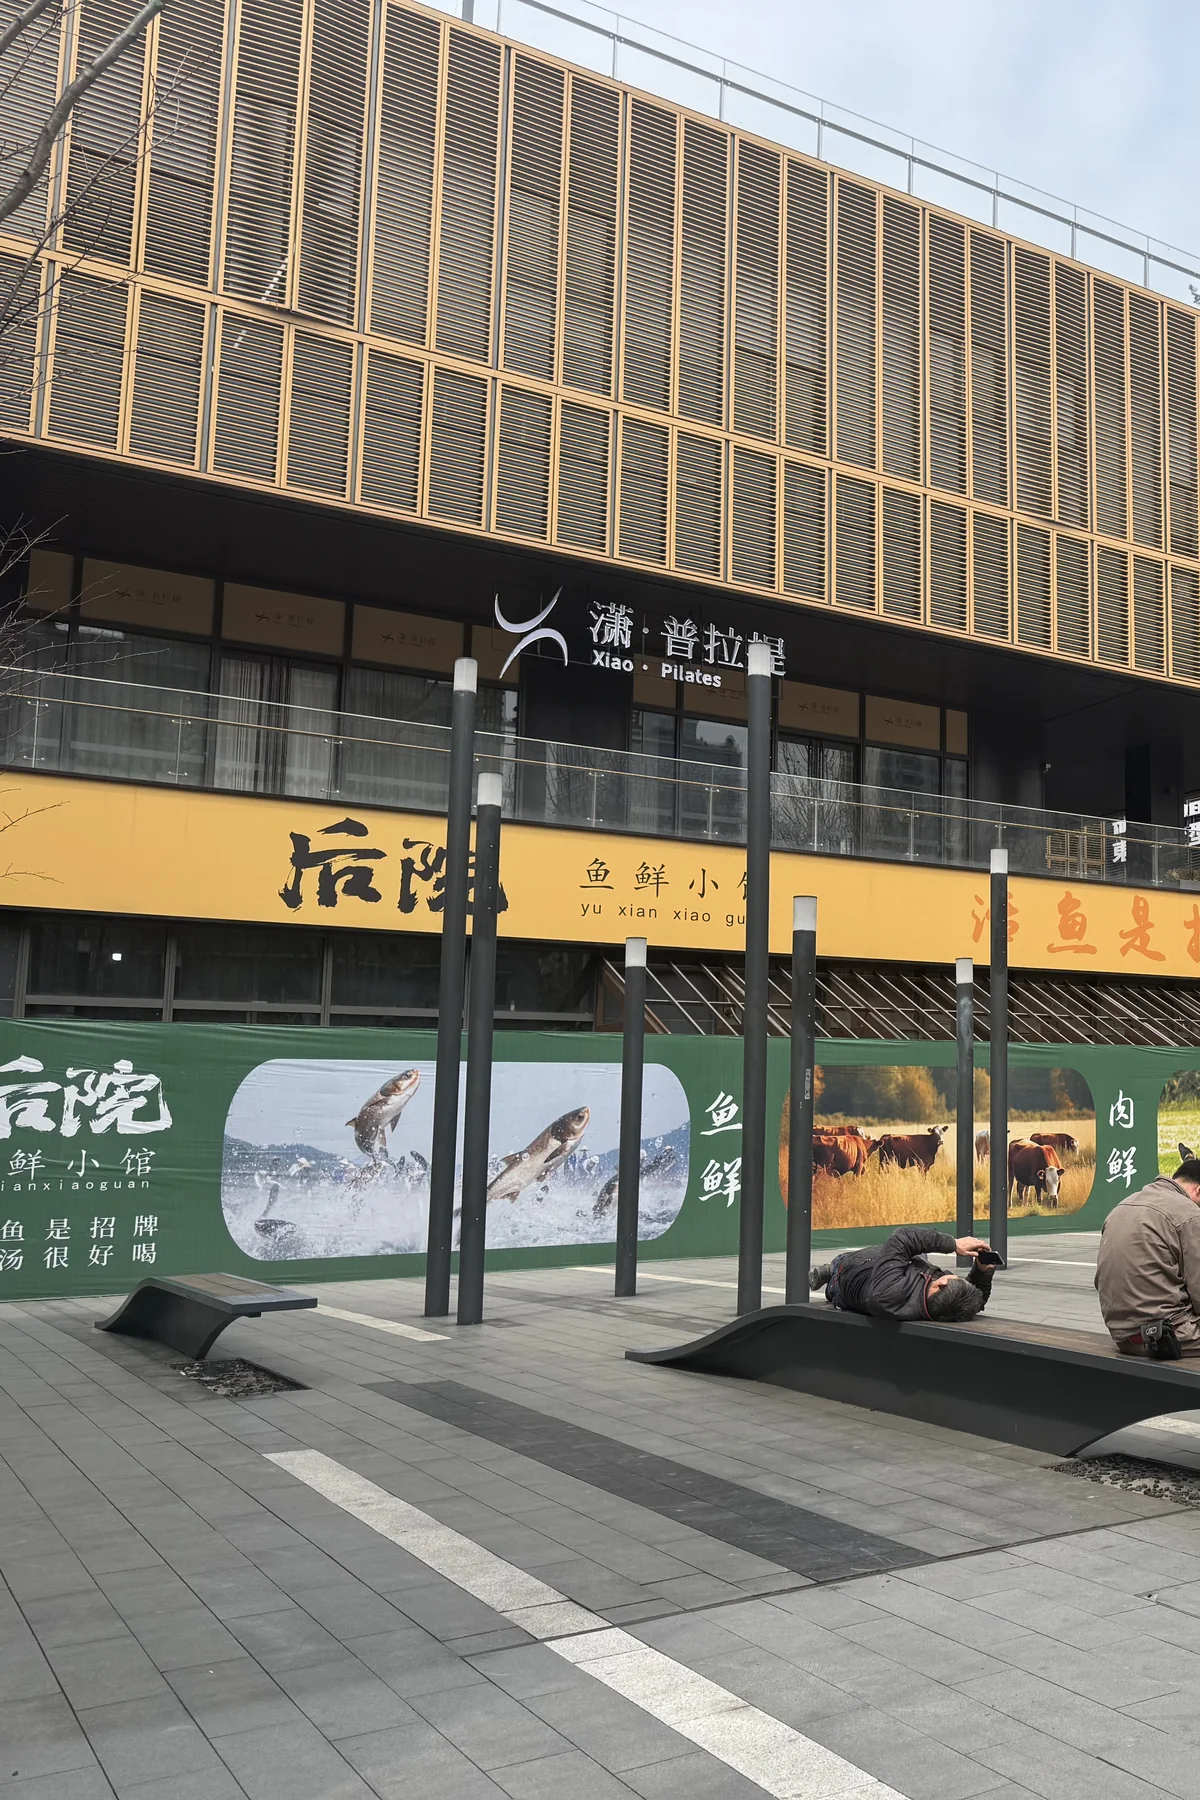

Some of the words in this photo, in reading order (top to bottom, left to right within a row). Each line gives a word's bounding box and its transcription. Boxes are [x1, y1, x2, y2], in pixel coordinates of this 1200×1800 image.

[592, 649, 634, 672] Xiao
[661, 662, 722, 688] Pilates
[579, 858, 748, 900] 鱼鲜小
[580, 903, 602, 918] yu
[618, 903, 658, 920] xian
[673, 905, 711, 923] xiao
[725, 909, 747, 926] gu
[698, 1090, 743, 1207] 鱼鲜
[1106, 1089, 1138, 1188] 肉鲜
[0, 1215, 159, 1242] 鱼是招牌
[0, 1242, 157, 1271] 汤很好喝
